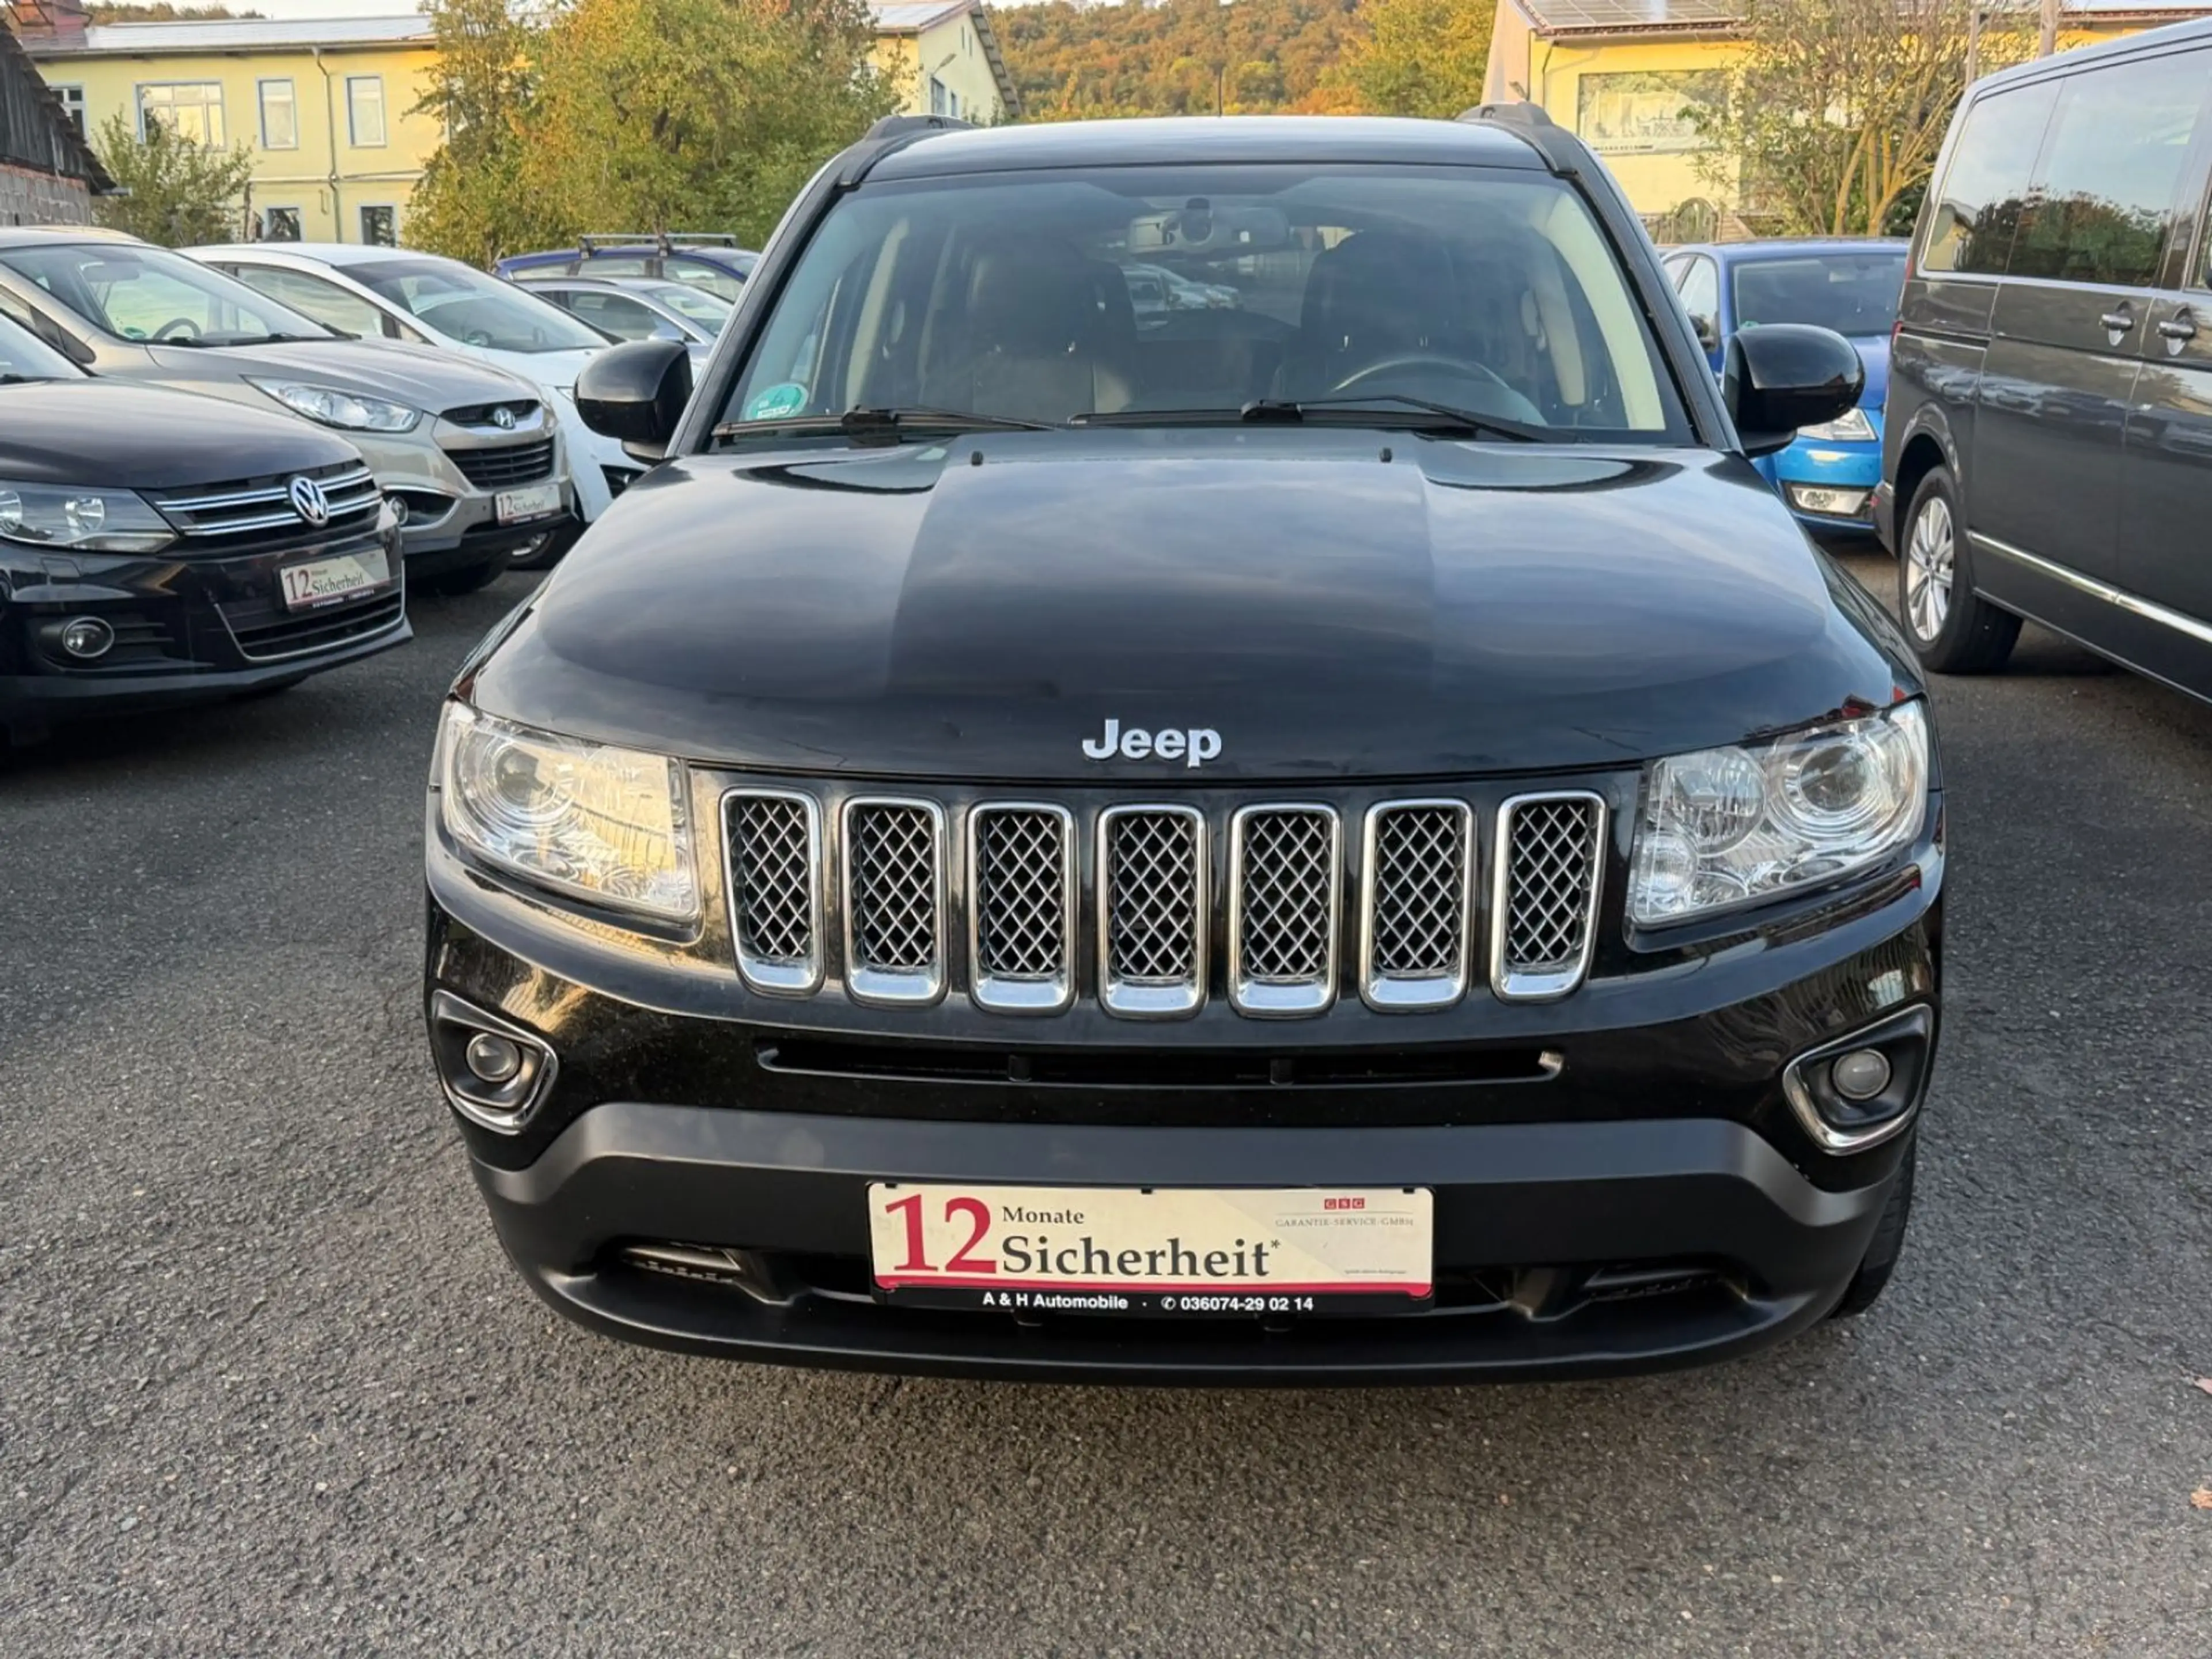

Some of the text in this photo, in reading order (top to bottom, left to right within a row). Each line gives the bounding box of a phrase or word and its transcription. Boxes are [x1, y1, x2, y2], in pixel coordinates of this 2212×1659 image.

[498, 494, 514, 519] 12
[285, 569, 313, 601] 12
[1082, 719, 1222, 768] Jeep
[1002, 1206, 1085, 1224] Monate
[885, 1194, 997, 1274] 12
[982, 1291, 1314, 1311] A & H Automobile 036074-29 02 14
